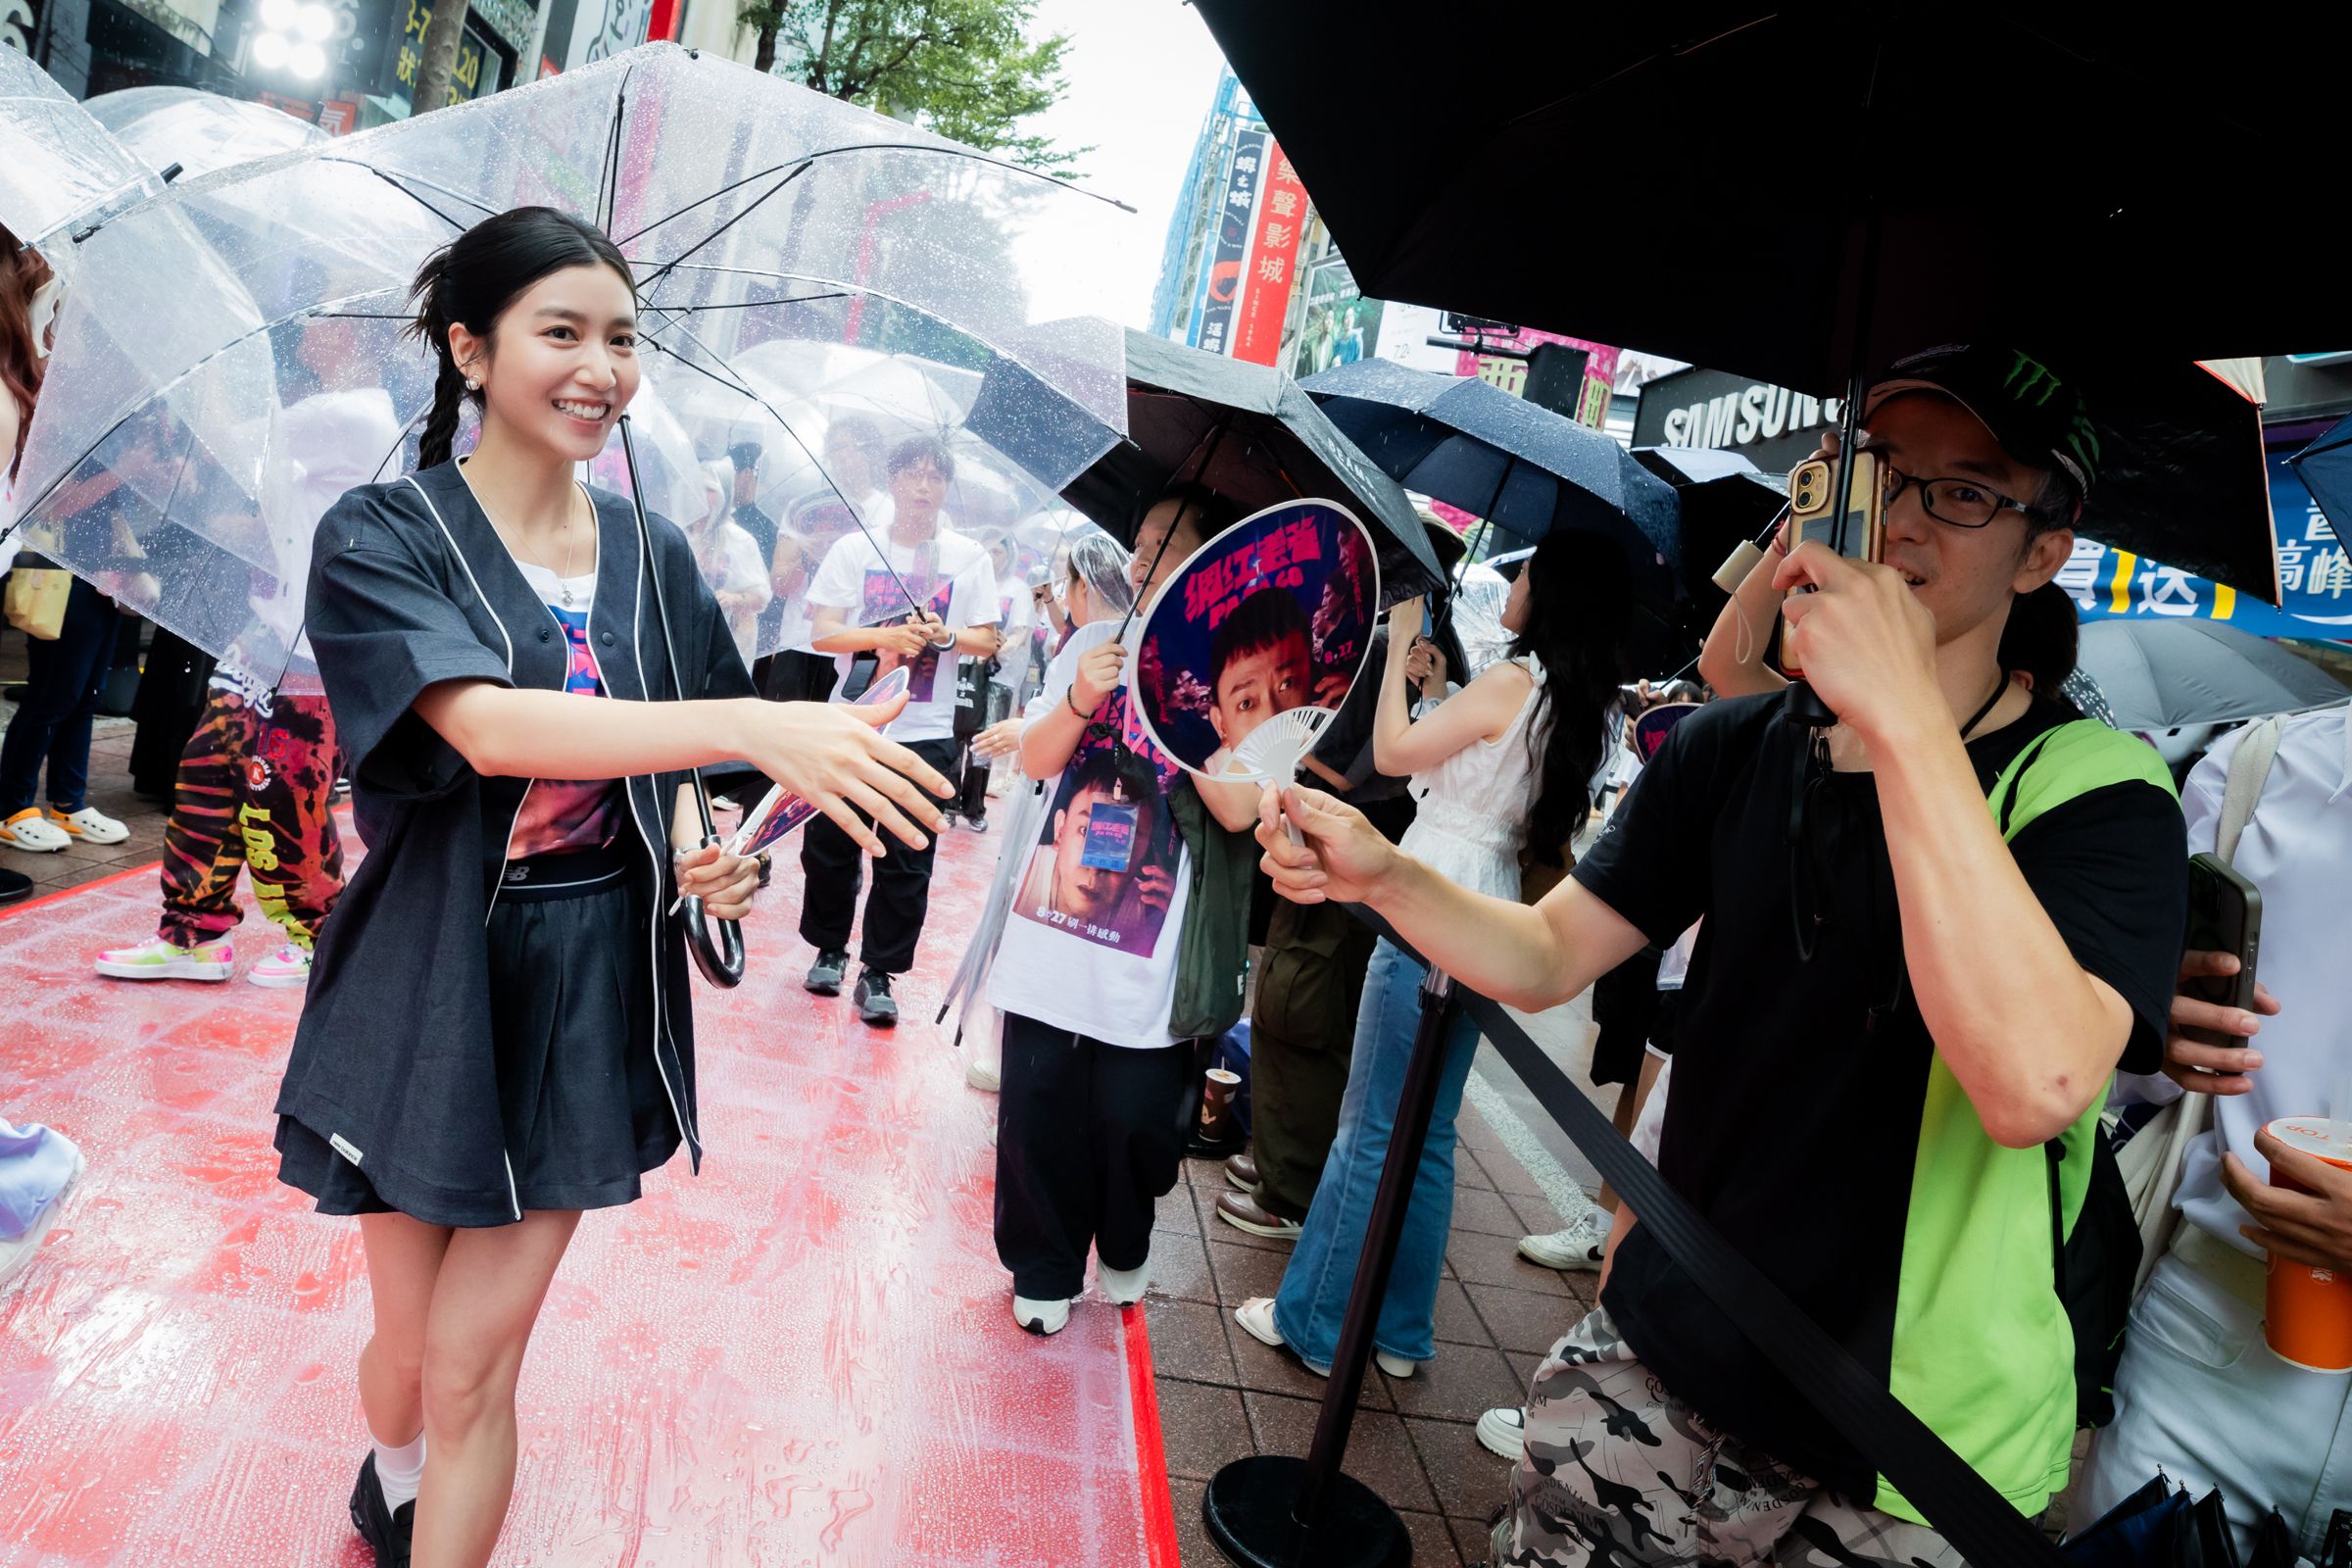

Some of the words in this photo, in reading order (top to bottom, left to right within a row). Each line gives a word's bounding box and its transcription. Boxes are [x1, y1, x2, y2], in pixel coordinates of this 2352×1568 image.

[1257, 157, 1301, 283] 樂聲影城
[1250, 287, 1260, 318] SINCE
